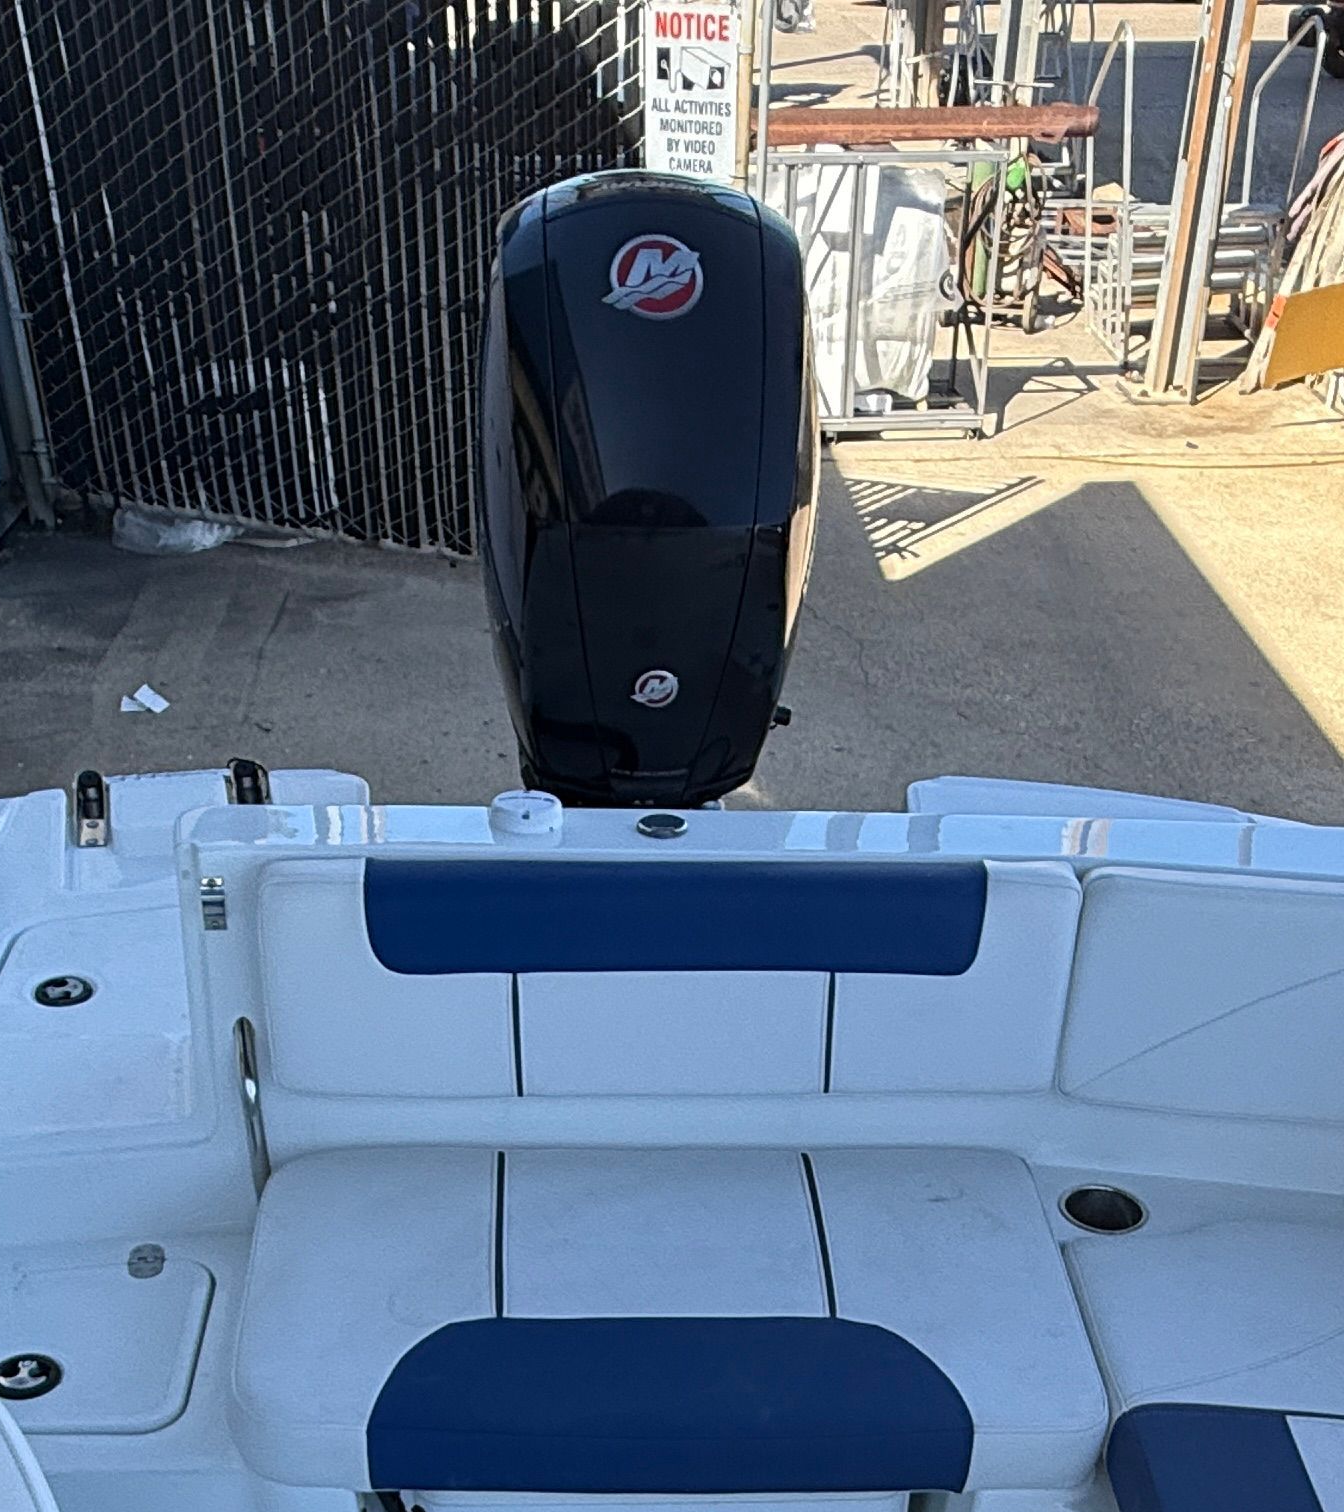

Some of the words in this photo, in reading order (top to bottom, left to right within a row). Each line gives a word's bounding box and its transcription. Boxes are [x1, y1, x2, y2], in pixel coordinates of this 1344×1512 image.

[655, 11, 730, 42] NOTICE
[651, 97, 671, 112] ALL
[674, 99, 731, 117] ACTIVITIES
[659, 118, 723, 136] MONITORED
[667, 138, 680, 153] BY
[684, 139, 715, 155] VIDEO
[669, 157, 713, 174] CAMERA
